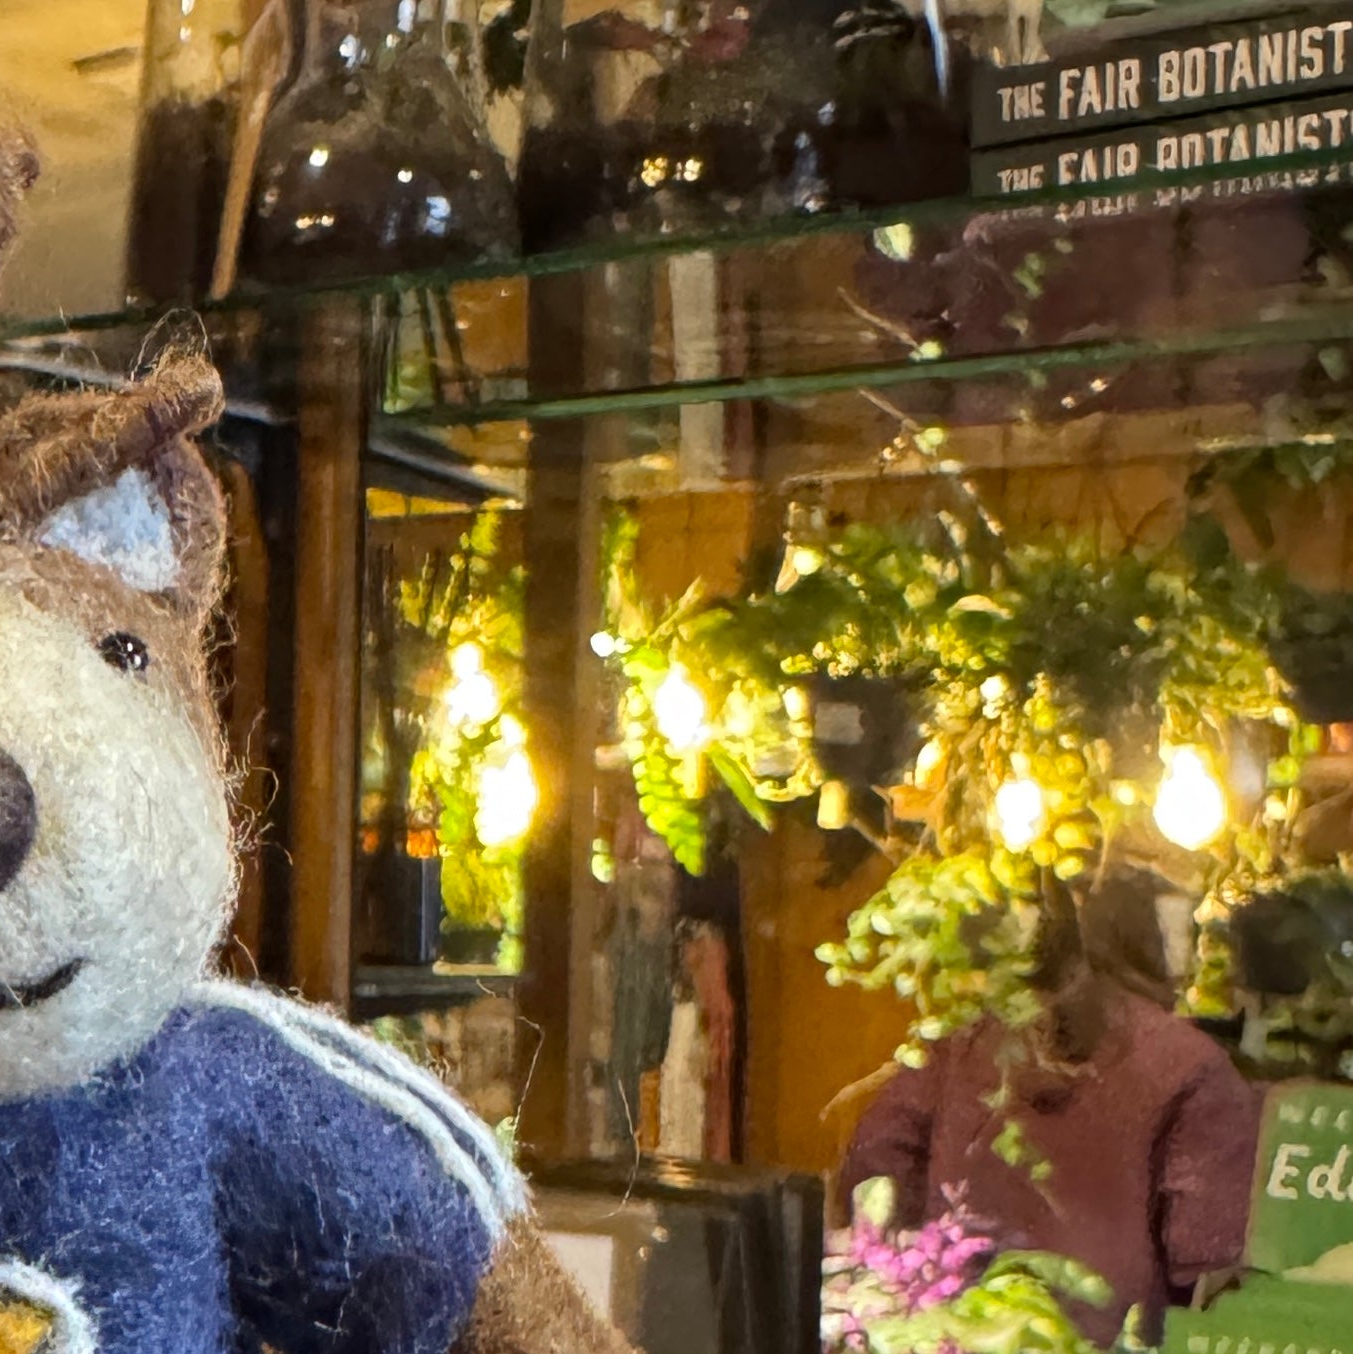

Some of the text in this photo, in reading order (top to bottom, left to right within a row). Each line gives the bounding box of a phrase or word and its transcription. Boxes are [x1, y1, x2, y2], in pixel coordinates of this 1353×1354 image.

[997, 21, 1353, 122] THE FAIR BOTANIST
[997, 164, 1045, 193] THE
[1156, 108, 1353, 172] BOTANIST
